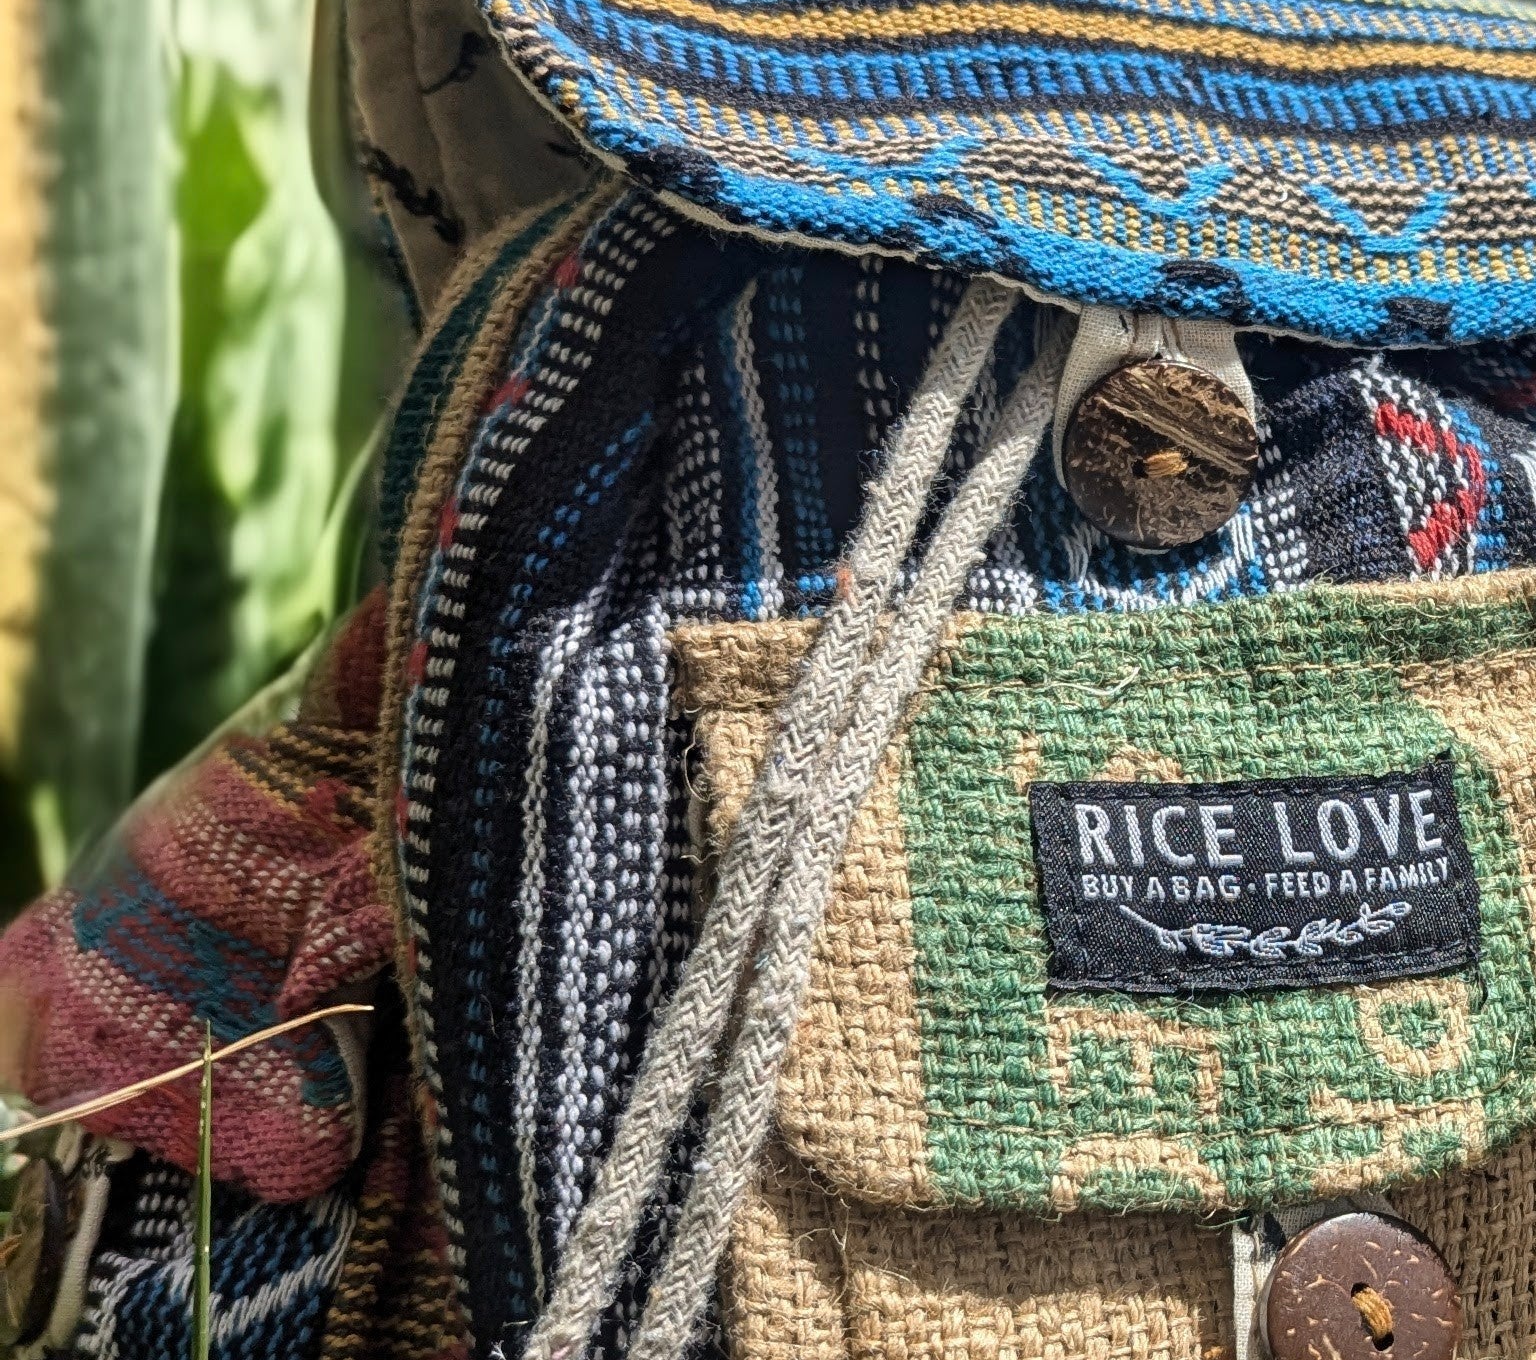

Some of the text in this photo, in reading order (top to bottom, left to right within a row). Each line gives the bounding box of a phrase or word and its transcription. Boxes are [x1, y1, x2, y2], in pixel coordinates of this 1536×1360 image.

[1074, 789, 1443, 868] RICE LOVE
[1081, 856, 1448, 903] BUY A BAG FEED A FAMILY
